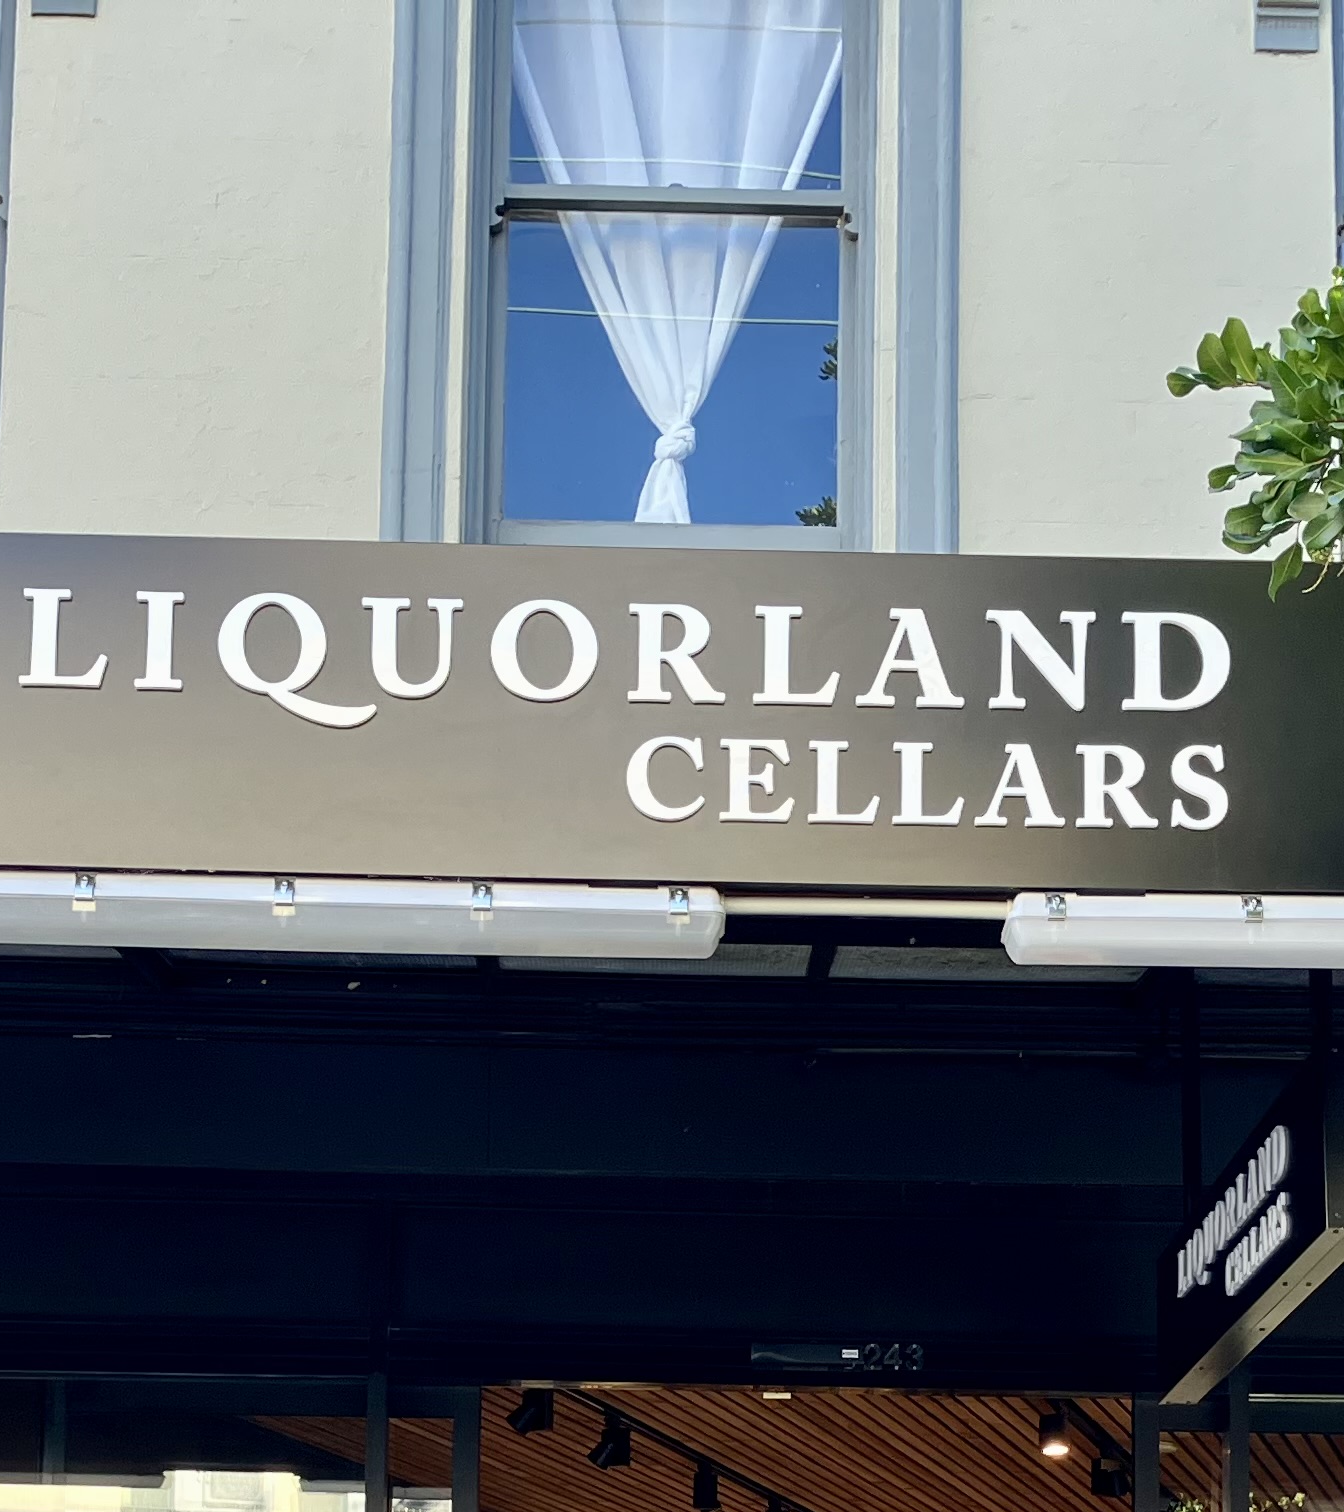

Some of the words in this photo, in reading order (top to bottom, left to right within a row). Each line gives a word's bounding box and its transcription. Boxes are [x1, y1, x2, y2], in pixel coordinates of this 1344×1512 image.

[19, 587, 1232, 729] LIQUORLAND
[626, 735, 1230, 830] CELLARS
[1177, 1125, 1290, 1298] LIQUORLAND
[1225, 1192, 1291, 1297] CELLARS
[863, 1343, 924, 1371] 243
